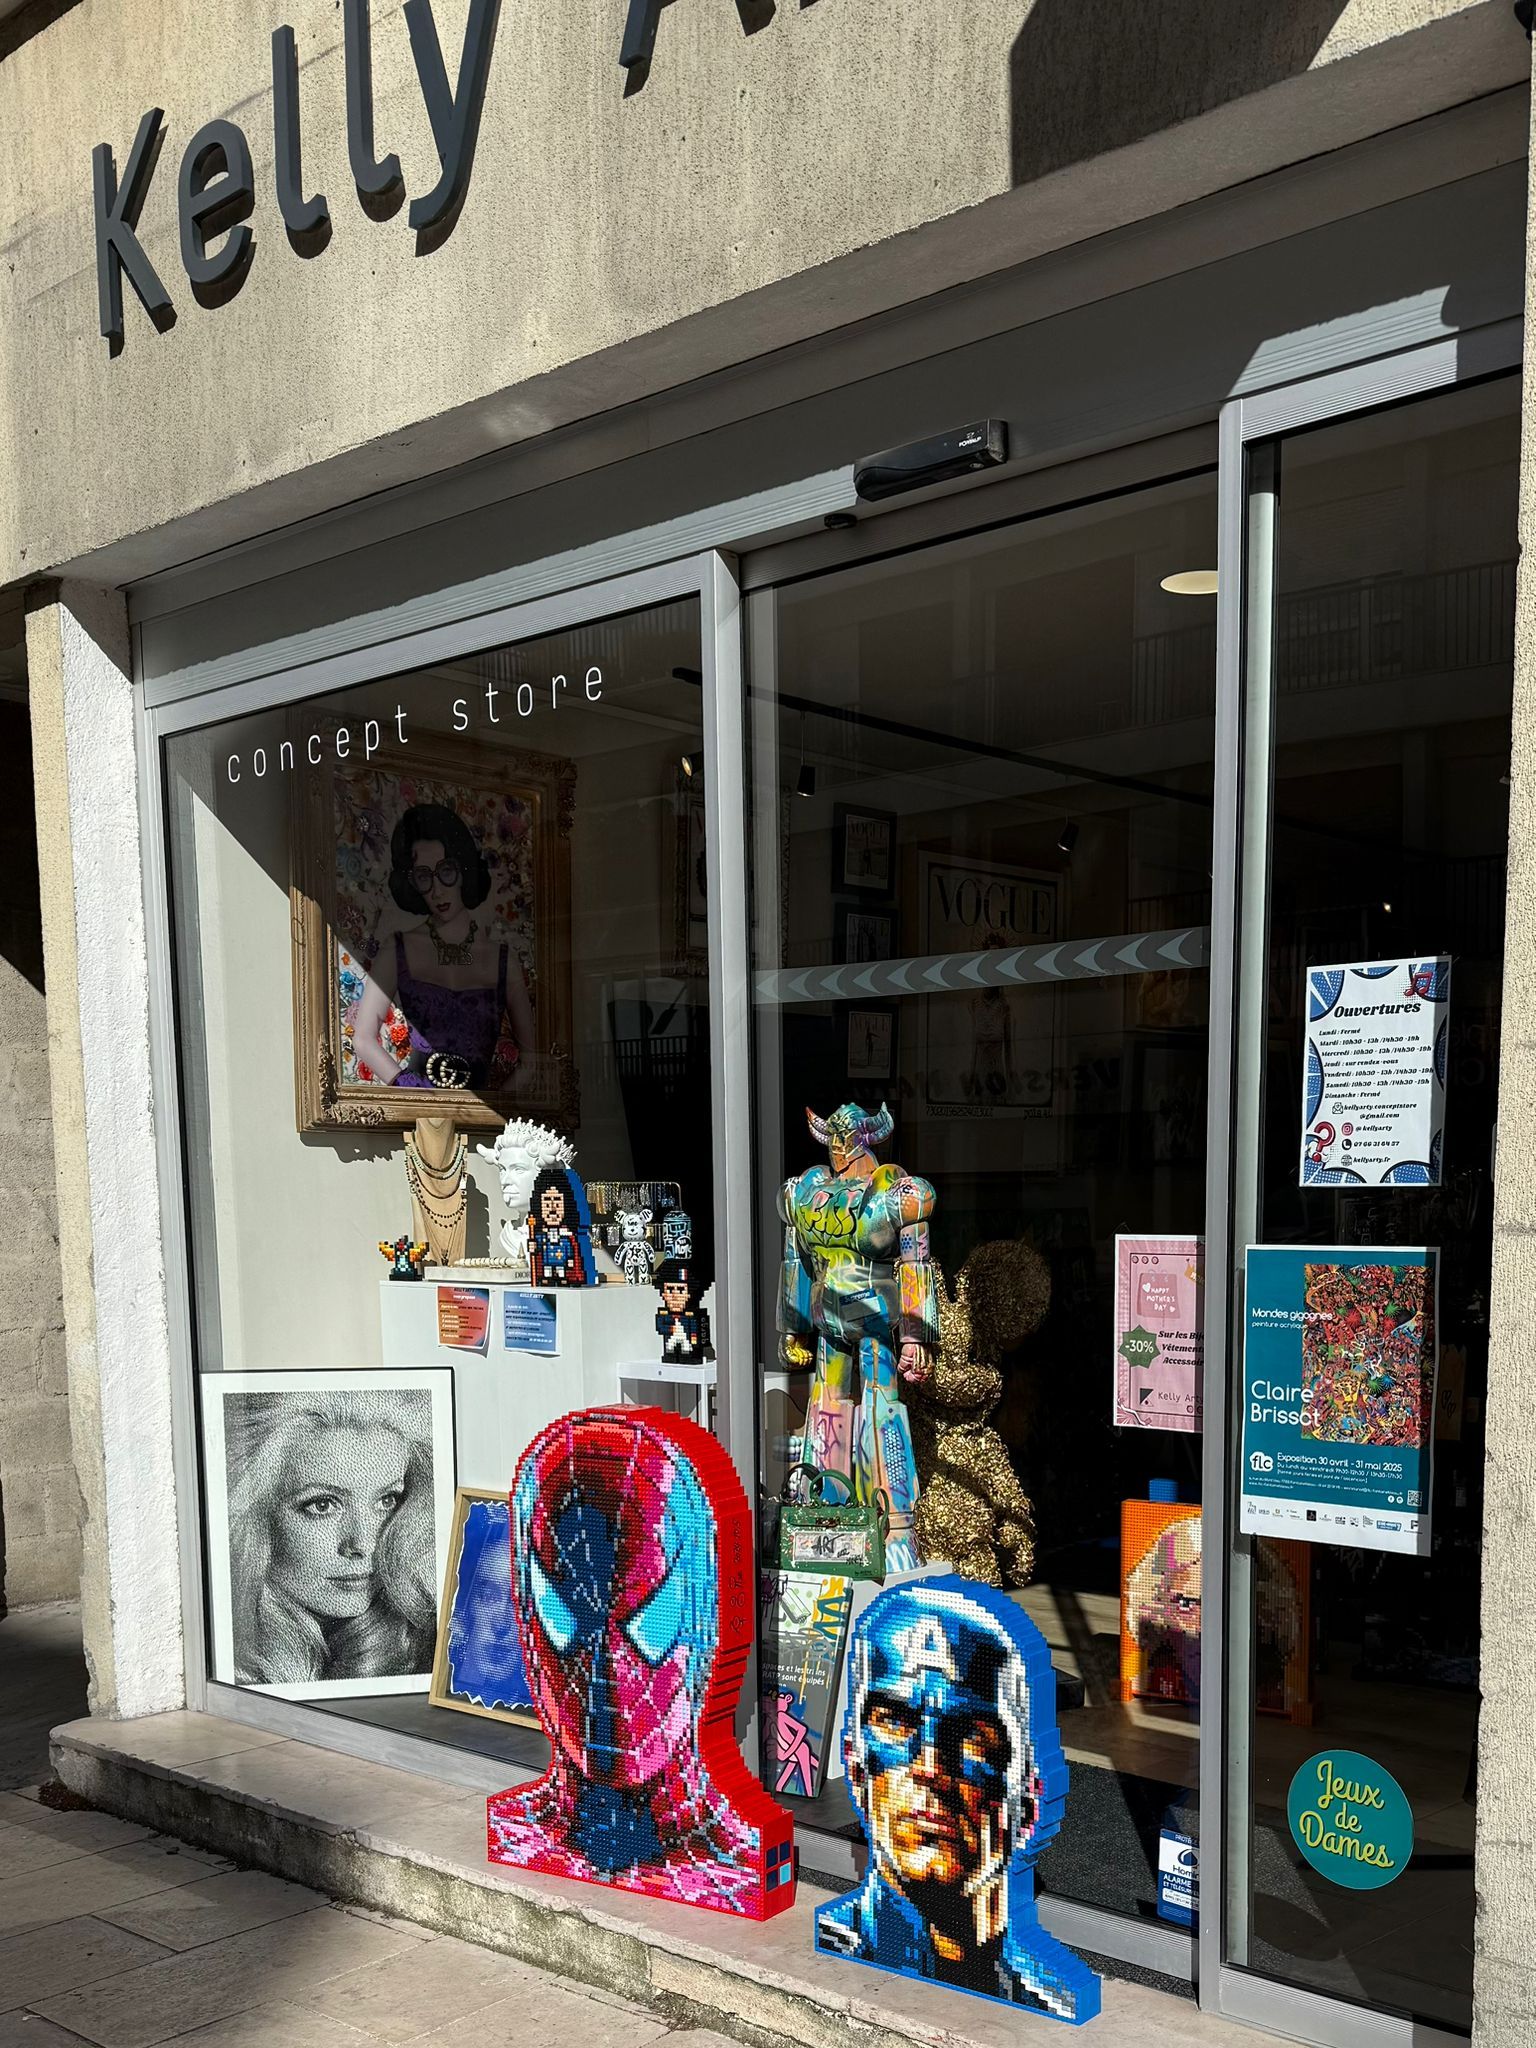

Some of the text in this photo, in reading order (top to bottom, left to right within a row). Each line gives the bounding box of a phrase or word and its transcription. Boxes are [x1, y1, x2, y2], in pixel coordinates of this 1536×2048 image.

[92, 0, 500, 338] Kelly
[227, 665, 603, 783] concept store
[935, 873, 1052, 936] VOGUE
[1334, 1002, 1421, 1018] Ouvertures
[1154, 1303, 1167, 1311] DAY
[1252, 1308, 1333, 1322] Mondes gigognes
[1158, 1330, 1174, 1338] Sur
[1176, 1331, 1188, 1339] les
[1125, 1339, 1154, 1353] -30%
[1158, 1392, 1180, 1403] Kelly
[1251, 1380, 1314, 1403] Claire
[1251, 1402, 1321, 1427] Brissot
[1252, 1455, 1271, 1469] flc
[1277, 1452, 1317, 1464] Exposition
[1318, 1456, 1328, 1465] 30
[1329, 1459, 1349, 1468] avril
[1355, 1460, 1363, 1469] 31
[1365, 1462, 1381, 1470] mai
[1383, 1462, 1403, 1472] 2025
[795, 1666, 805, 1674] les
[782, 1674, 798, 1682] sont
[798, 1676, 825, 1686] éuipés
[1317, 1759, 1385, 1809] Jeux
[1335, 1801, 1362, 1832] de
[1299, 1810, 1395, 1868] Dames
[1163, 1873, 1192, 1888] ALARME
